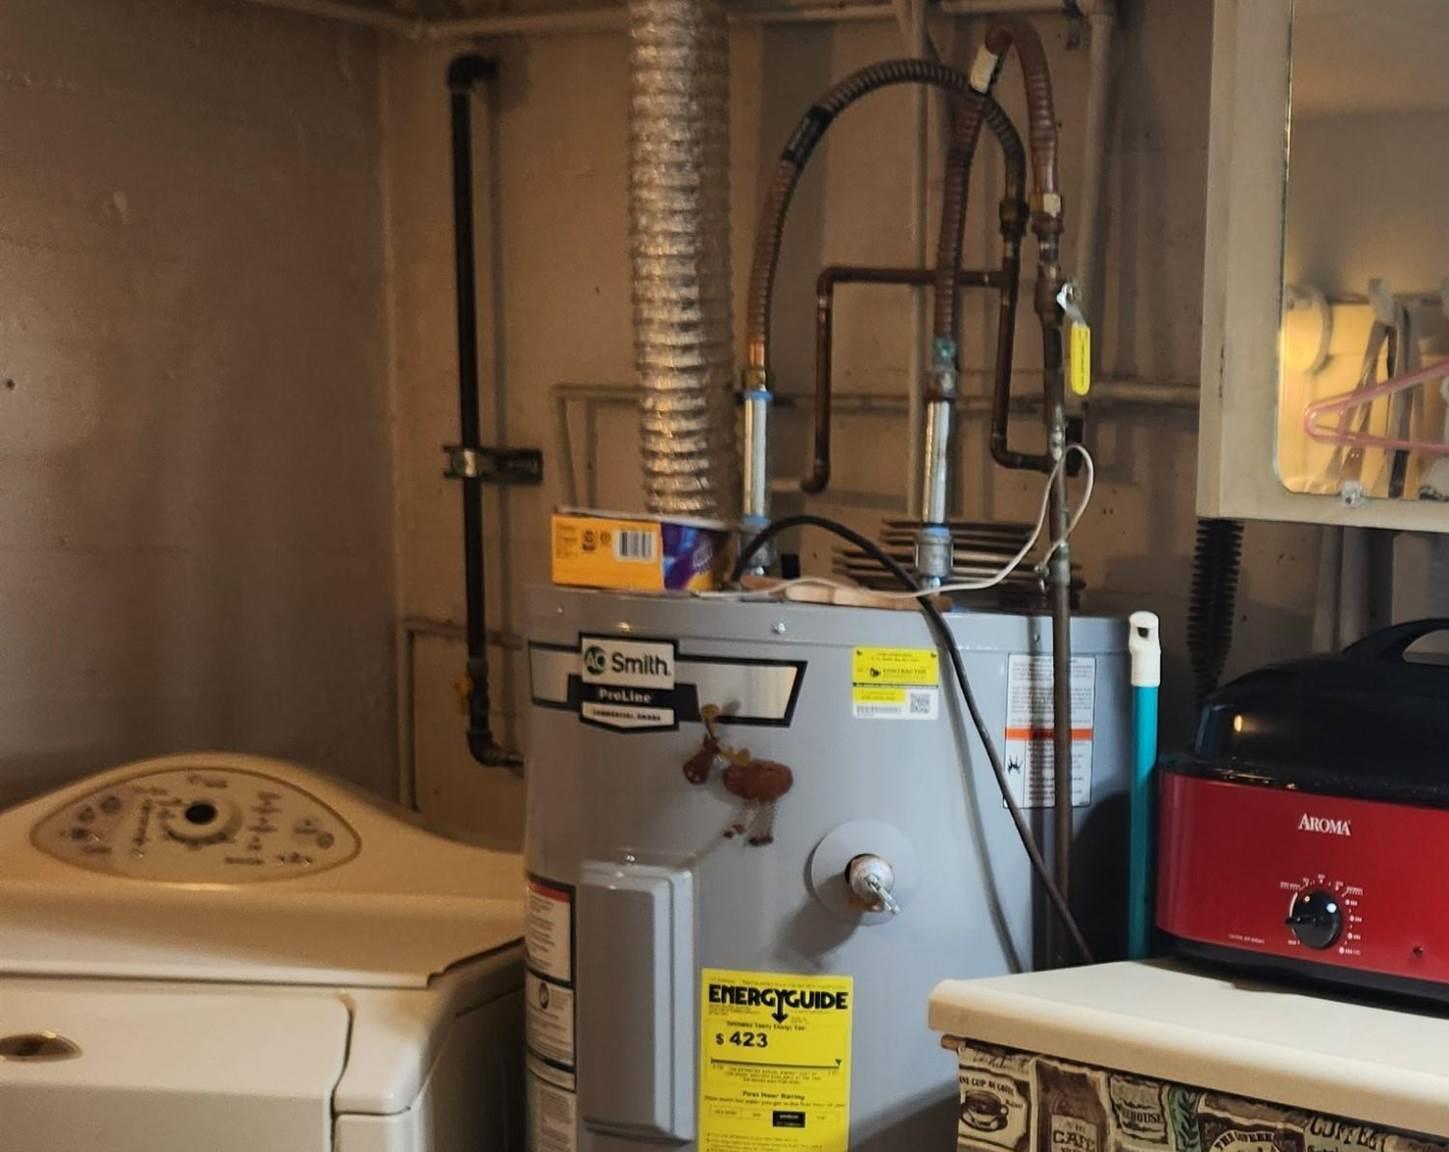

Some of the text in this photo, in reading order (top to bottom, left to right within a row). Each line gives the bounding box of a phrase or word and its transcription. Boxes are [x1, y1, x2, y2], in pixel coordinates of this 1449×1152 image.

[612, 652, 668, 676] Smith
[599, 689, 651, 702] ProLine
[1299, 813, 1351, 836] AROMA
[730, 1032, 768, 1048] 423
